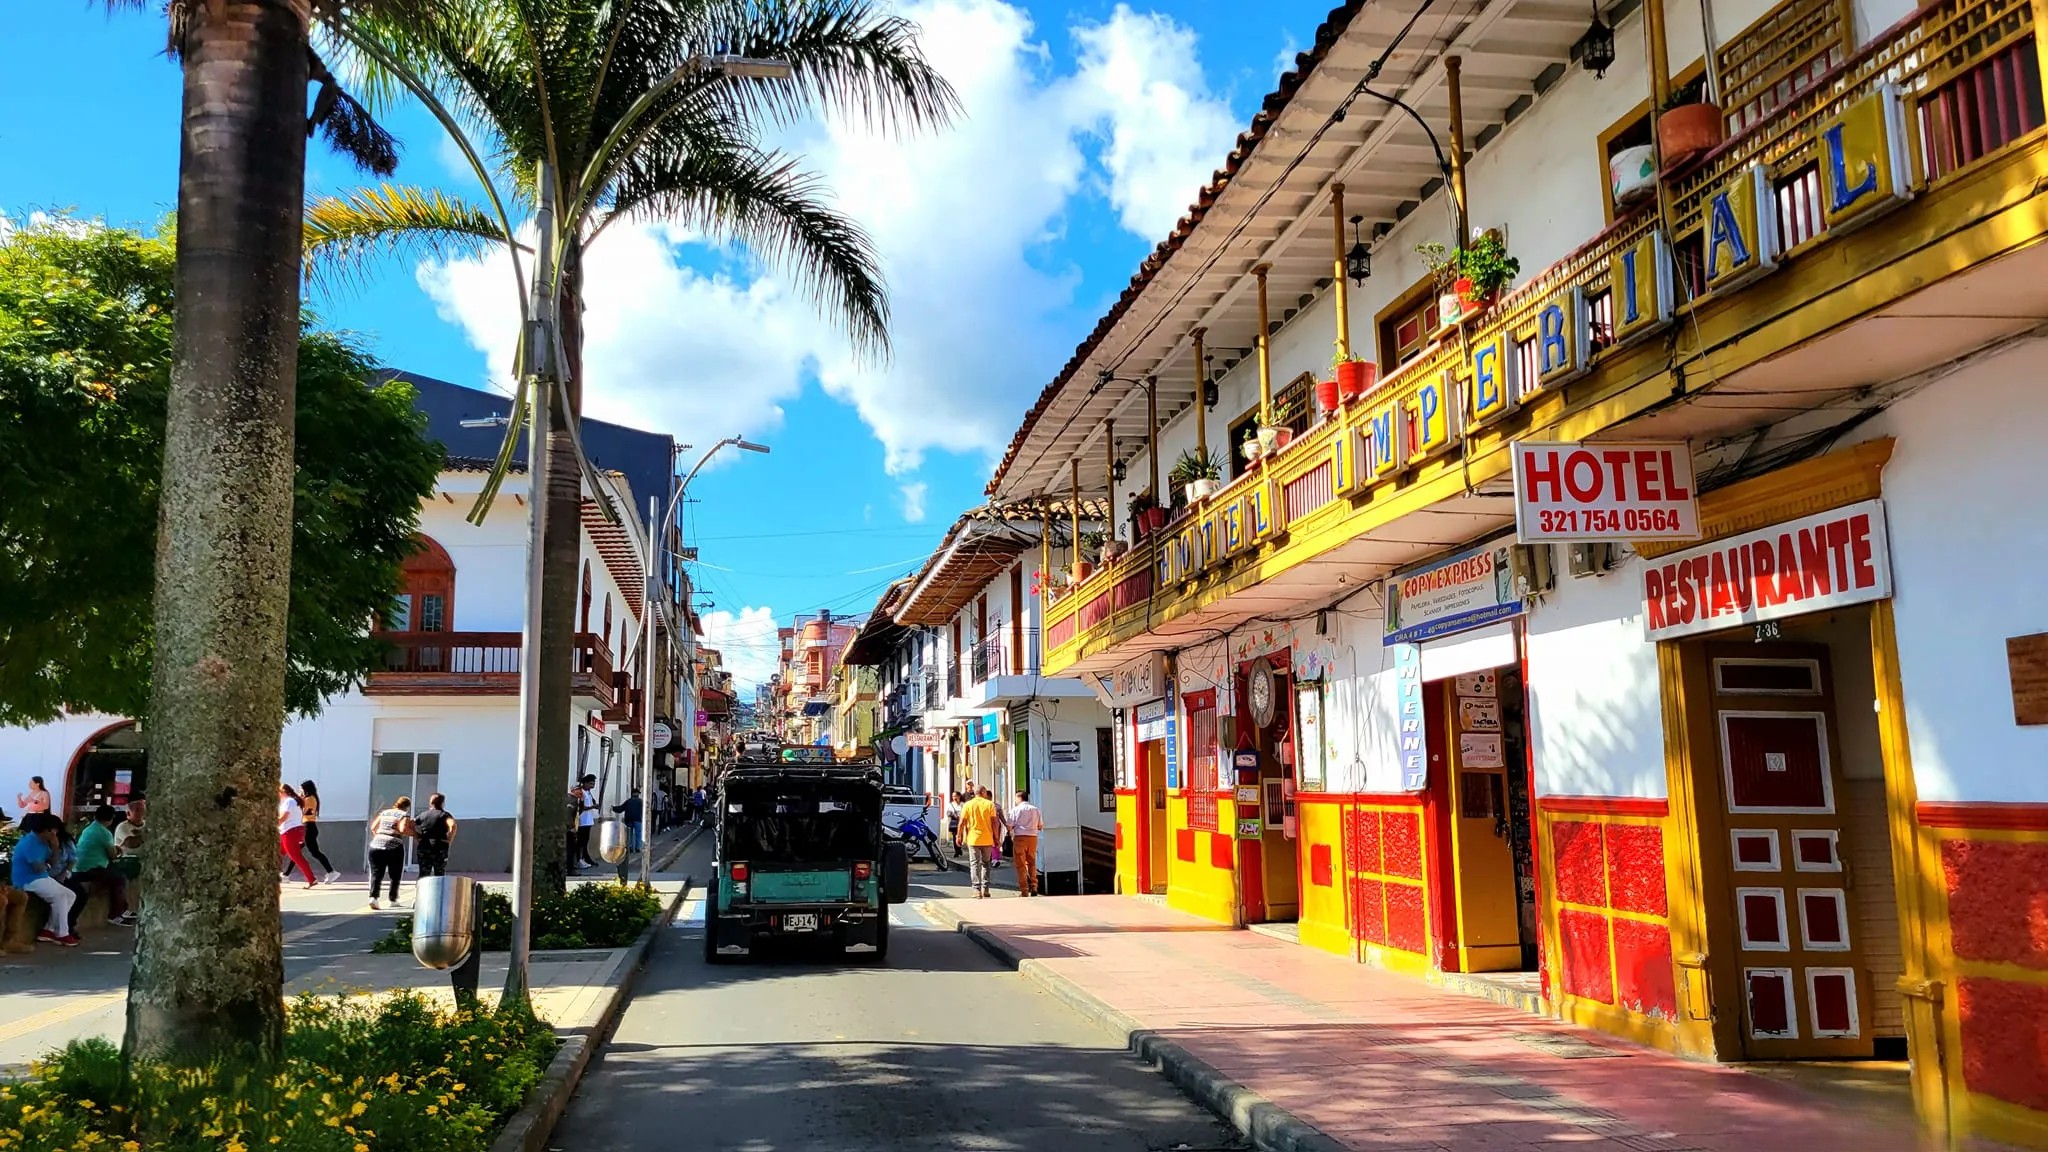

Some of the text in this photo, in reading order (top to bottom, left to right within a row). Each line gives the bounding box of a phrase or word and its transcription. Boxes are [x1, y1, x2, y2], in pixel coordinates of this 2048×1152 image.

[1160, 121, 1878, 586] HOTEL IMPERIAL
[1524, 450, 1688, 503] HOTEL
[1540, 509, 1680, 532] 321 754 0564
[1404, 551, 1492, 599] COPY EXPRESS
[1645, 513, 1876, 631] RESTAURANTE
[1401, 648, 1422, 787] INTERNET
